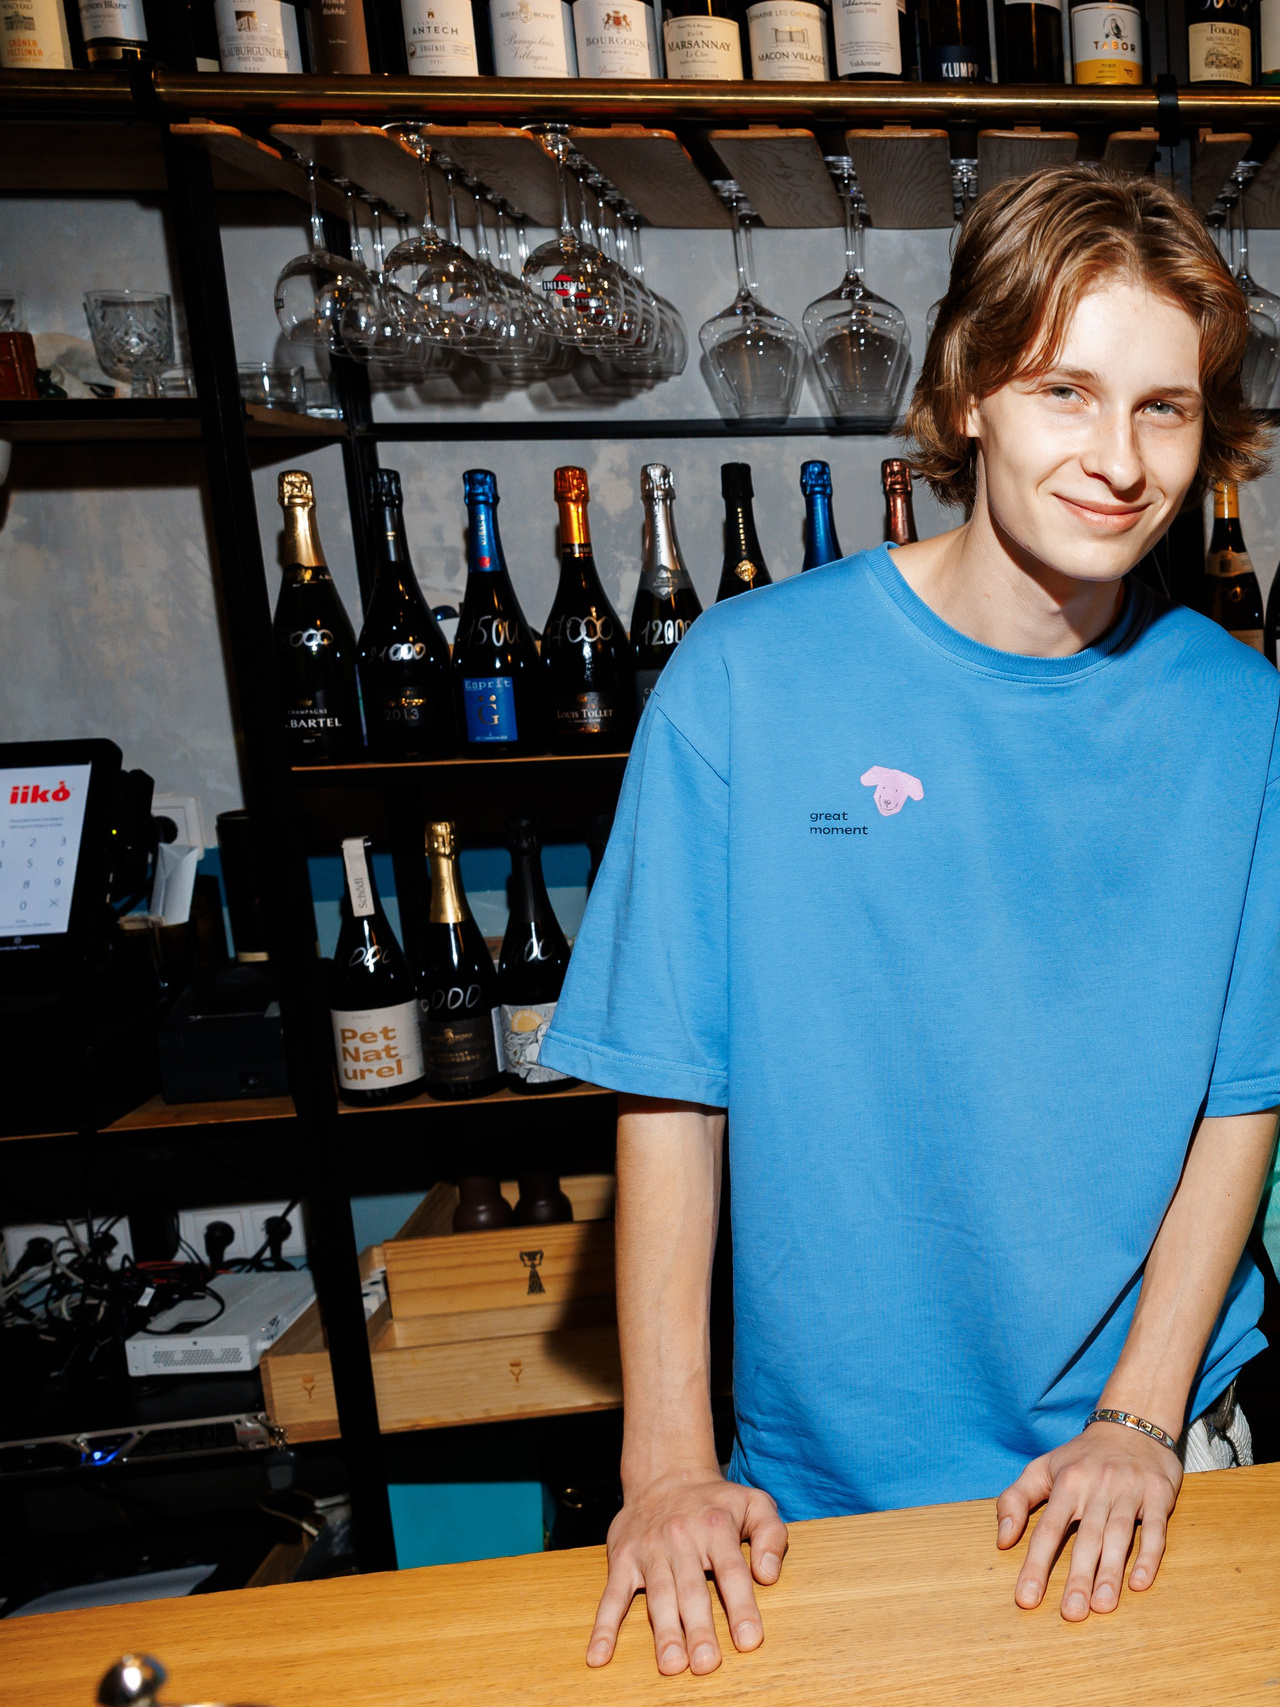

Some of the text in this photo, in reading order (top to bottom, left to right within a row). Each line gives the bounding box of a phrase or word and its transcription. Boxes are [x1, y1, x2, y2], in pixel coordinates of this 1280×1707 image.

[411, 26, 459, 36] ANTECH
[668, 40, 731, 52] MARSANNAY
[1093, 40, 1136, 54] TABOR
[941, 62, 979, 78] KLUMPP
[543, 281, 587, 291] MARTINI
[464, 678, 511, 691] Esprit
[384, 707, 419, 723] 2013
[556, 708, 614, 720] LOUIS TOLLET
[9, 781, 71, 805] iiko
[809, 811, 848, 822] great
[809, 825, 868, 835] moment
[341, 1044, 399, 1062] Nat
[343, 1058, 403, 1080] urel
